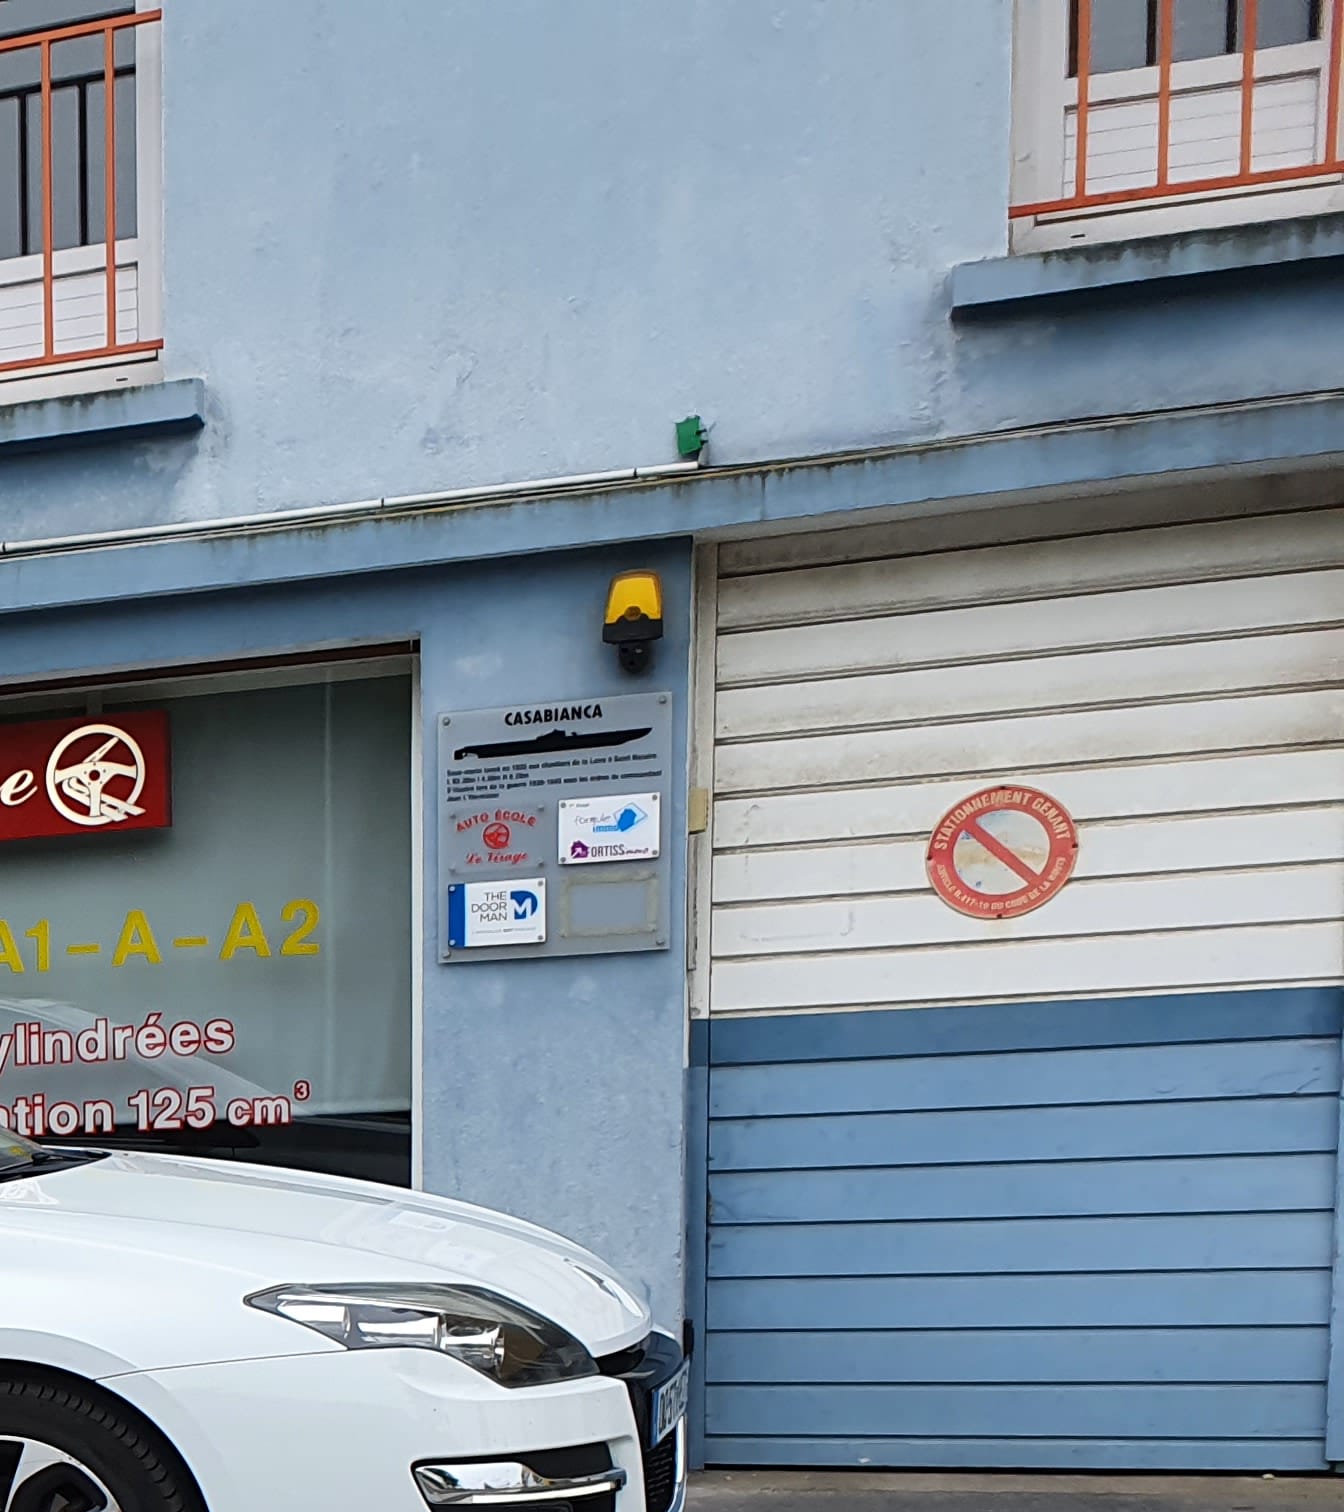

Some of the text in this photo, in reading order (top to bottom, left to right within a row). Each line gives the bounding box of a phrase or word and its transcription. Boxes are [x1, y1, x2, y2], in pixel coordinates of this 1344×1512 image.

[504, 704, 603, 726] CASABIANCA
[456, 808, 537, 832] AUTO ÉCOLE
[934, 790, 1033, 850] STATIONNEMENT
[471, 901, 507, 914] DOOR
[484, 891, 507, 902] THE
[479, 911, 508, 922] MAN
[128, 1086, 215, 1132] 125
